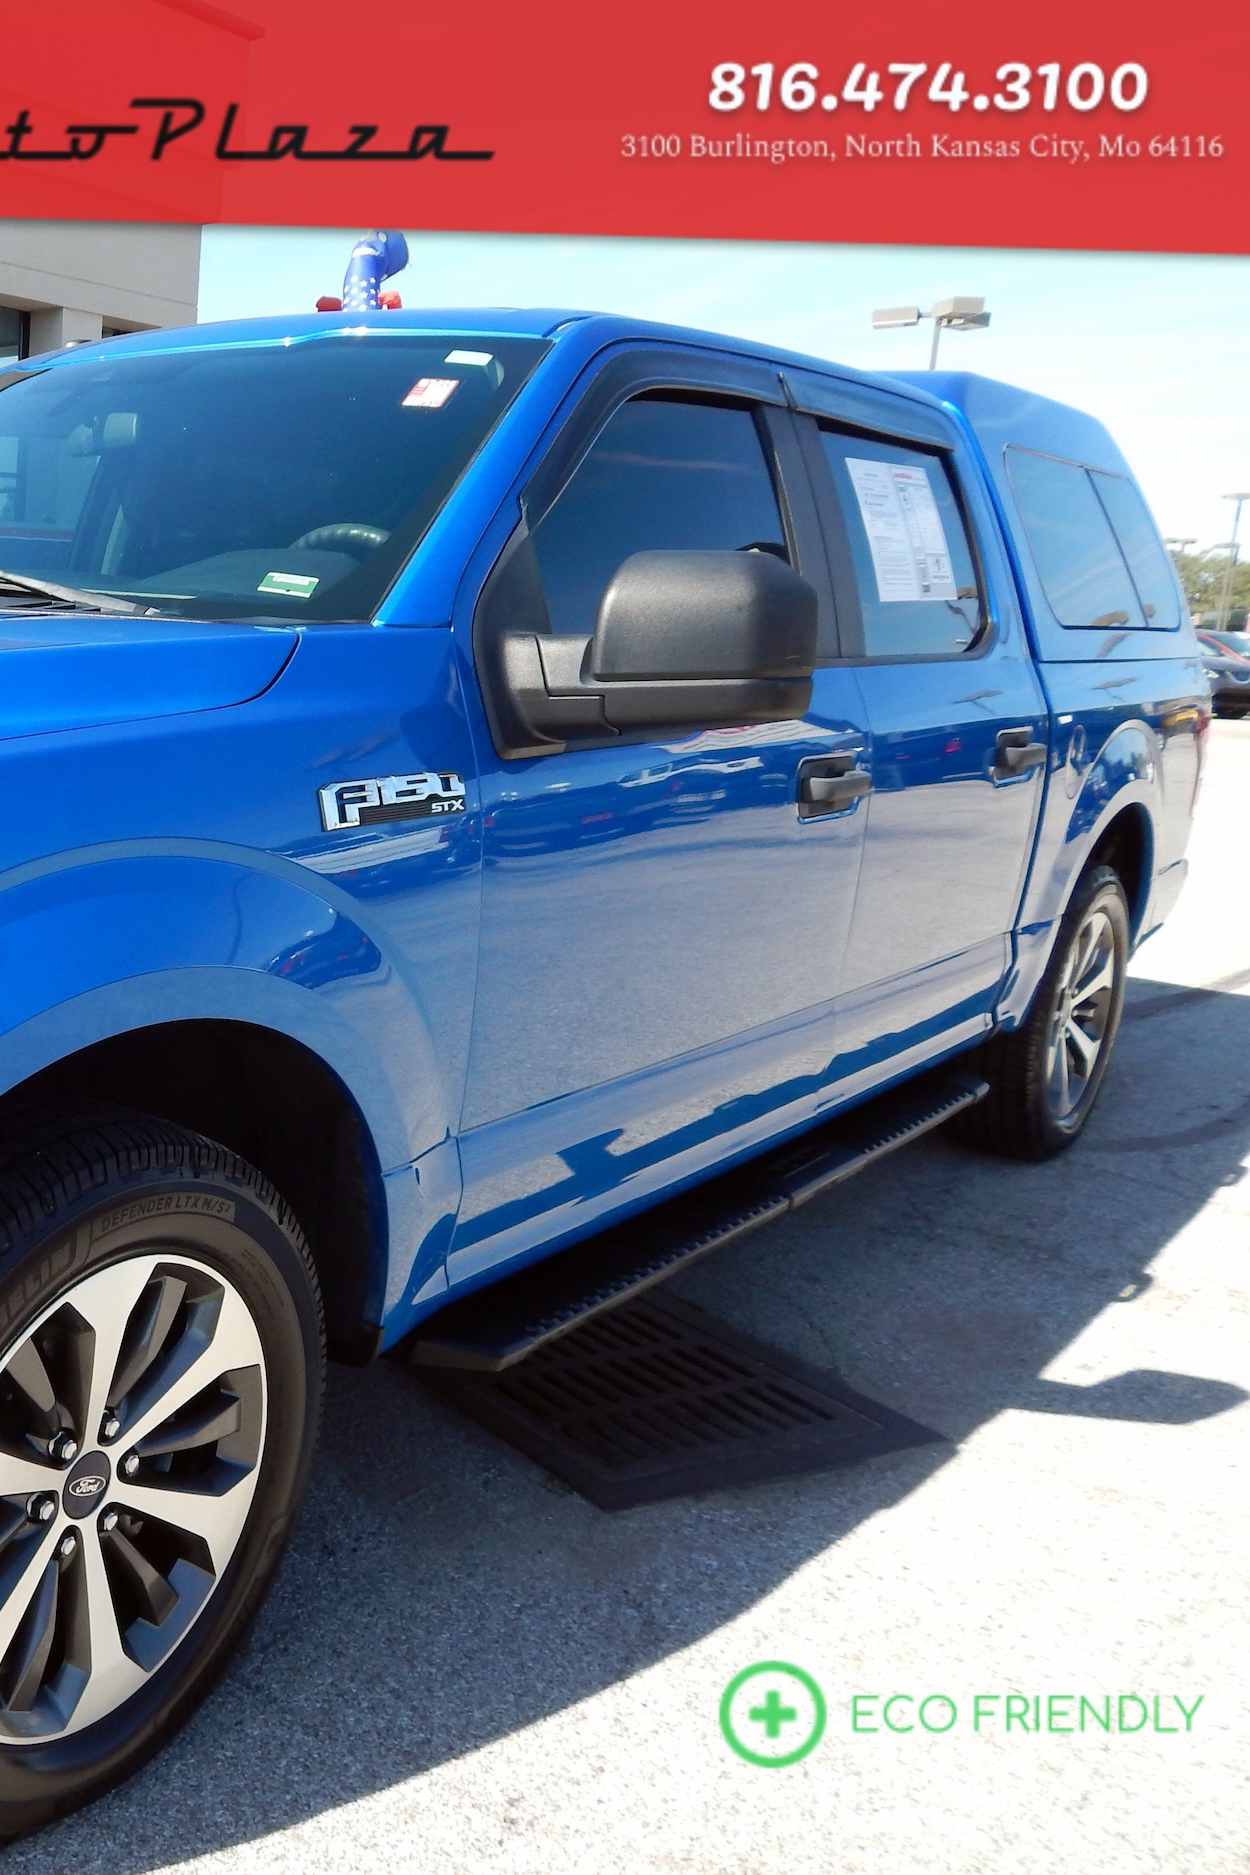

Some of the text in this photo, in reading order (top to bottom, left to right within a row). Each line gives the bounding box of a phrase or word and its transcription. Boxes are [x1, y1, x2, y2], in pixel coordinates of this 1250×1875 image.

[431, 798, 466, 813] STX
[100, 1196, 174, 1232] DEFENDER
[174, 1194, 199, 1210] LTX
